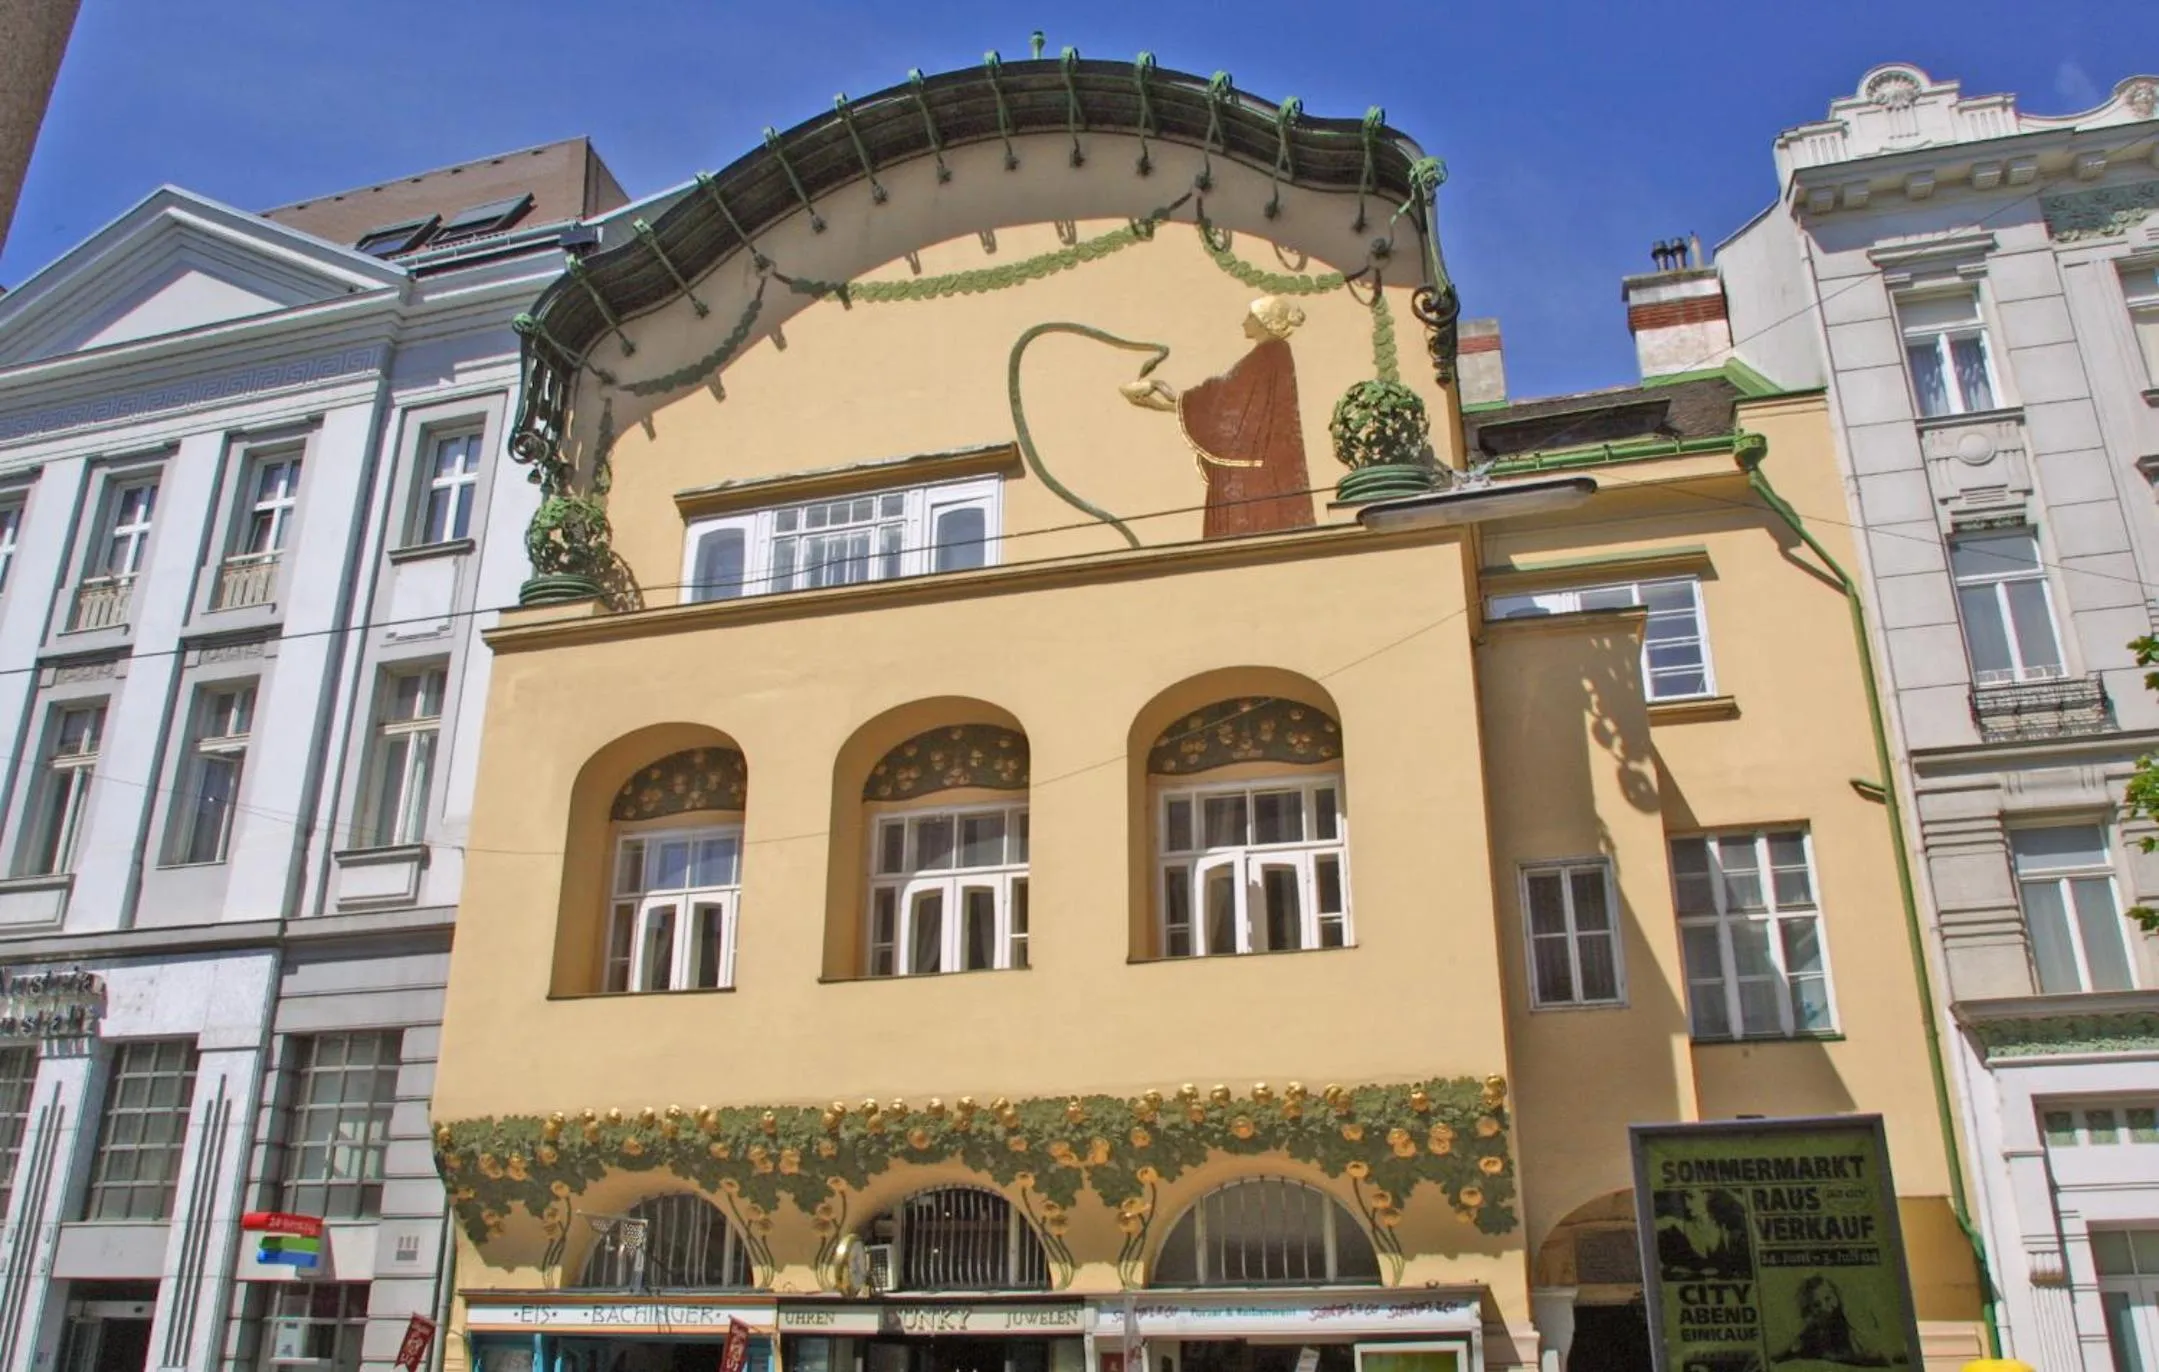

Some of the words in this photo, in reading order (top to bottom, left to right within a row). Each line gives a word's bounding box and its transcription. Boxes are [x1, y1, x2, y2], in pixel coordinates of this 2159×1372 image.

[1661, 1155, 1865, 1183] SOMMERMARKT
[1752, 1187, 1821, 1211] RAUS
[1757, 1216, 1875, 1241] VERKAUF
[1679, 1284, 1749, 1305] CITY
[785, 1311, 835, 1325] UHREN
[1004, 1309, 1079, 1328] JUWELEN
[1680, 1307, 1756, 1325] ABEND
[1681, 1327, 1759, 1342] EINKAUF
